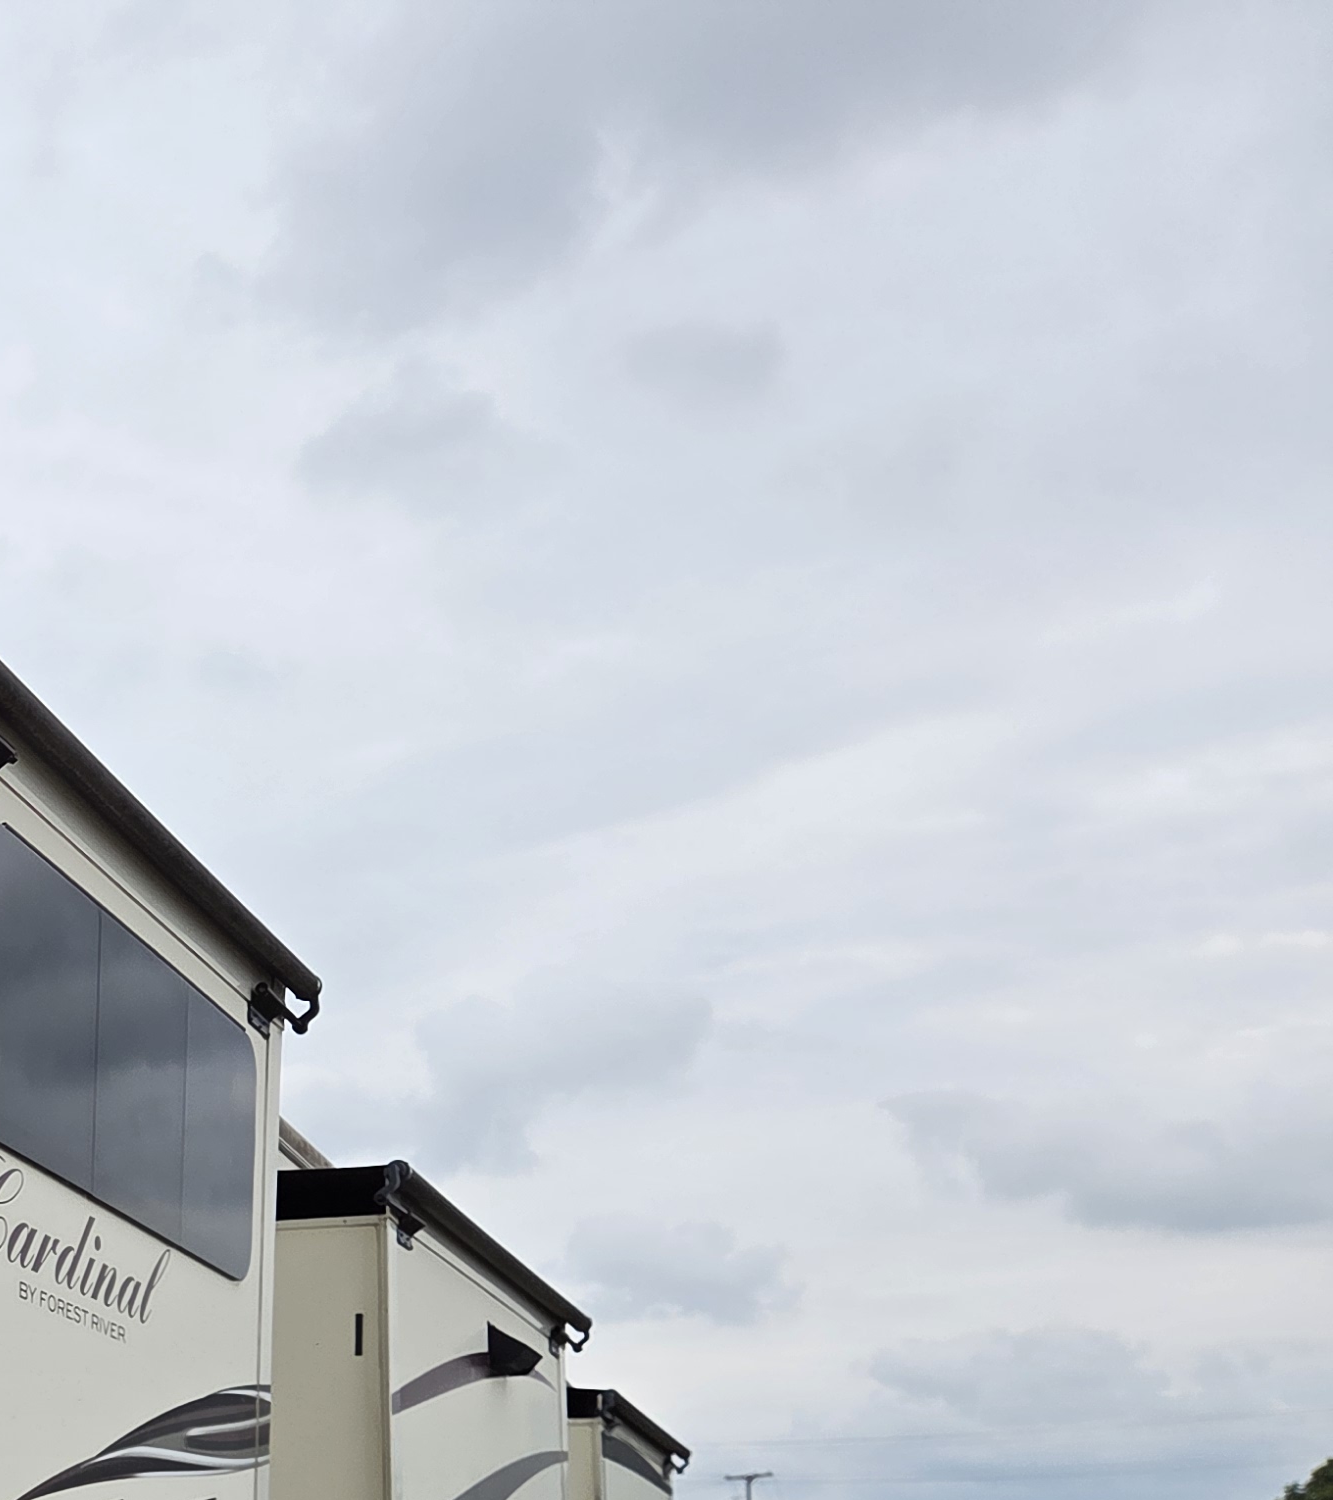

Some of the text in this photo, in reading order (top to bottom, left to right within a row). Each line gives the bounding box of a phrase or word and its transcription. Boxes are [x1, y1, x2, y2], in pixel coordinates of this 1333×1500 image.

[18, 1280, 127, 1344] BY FOREST RIVER
